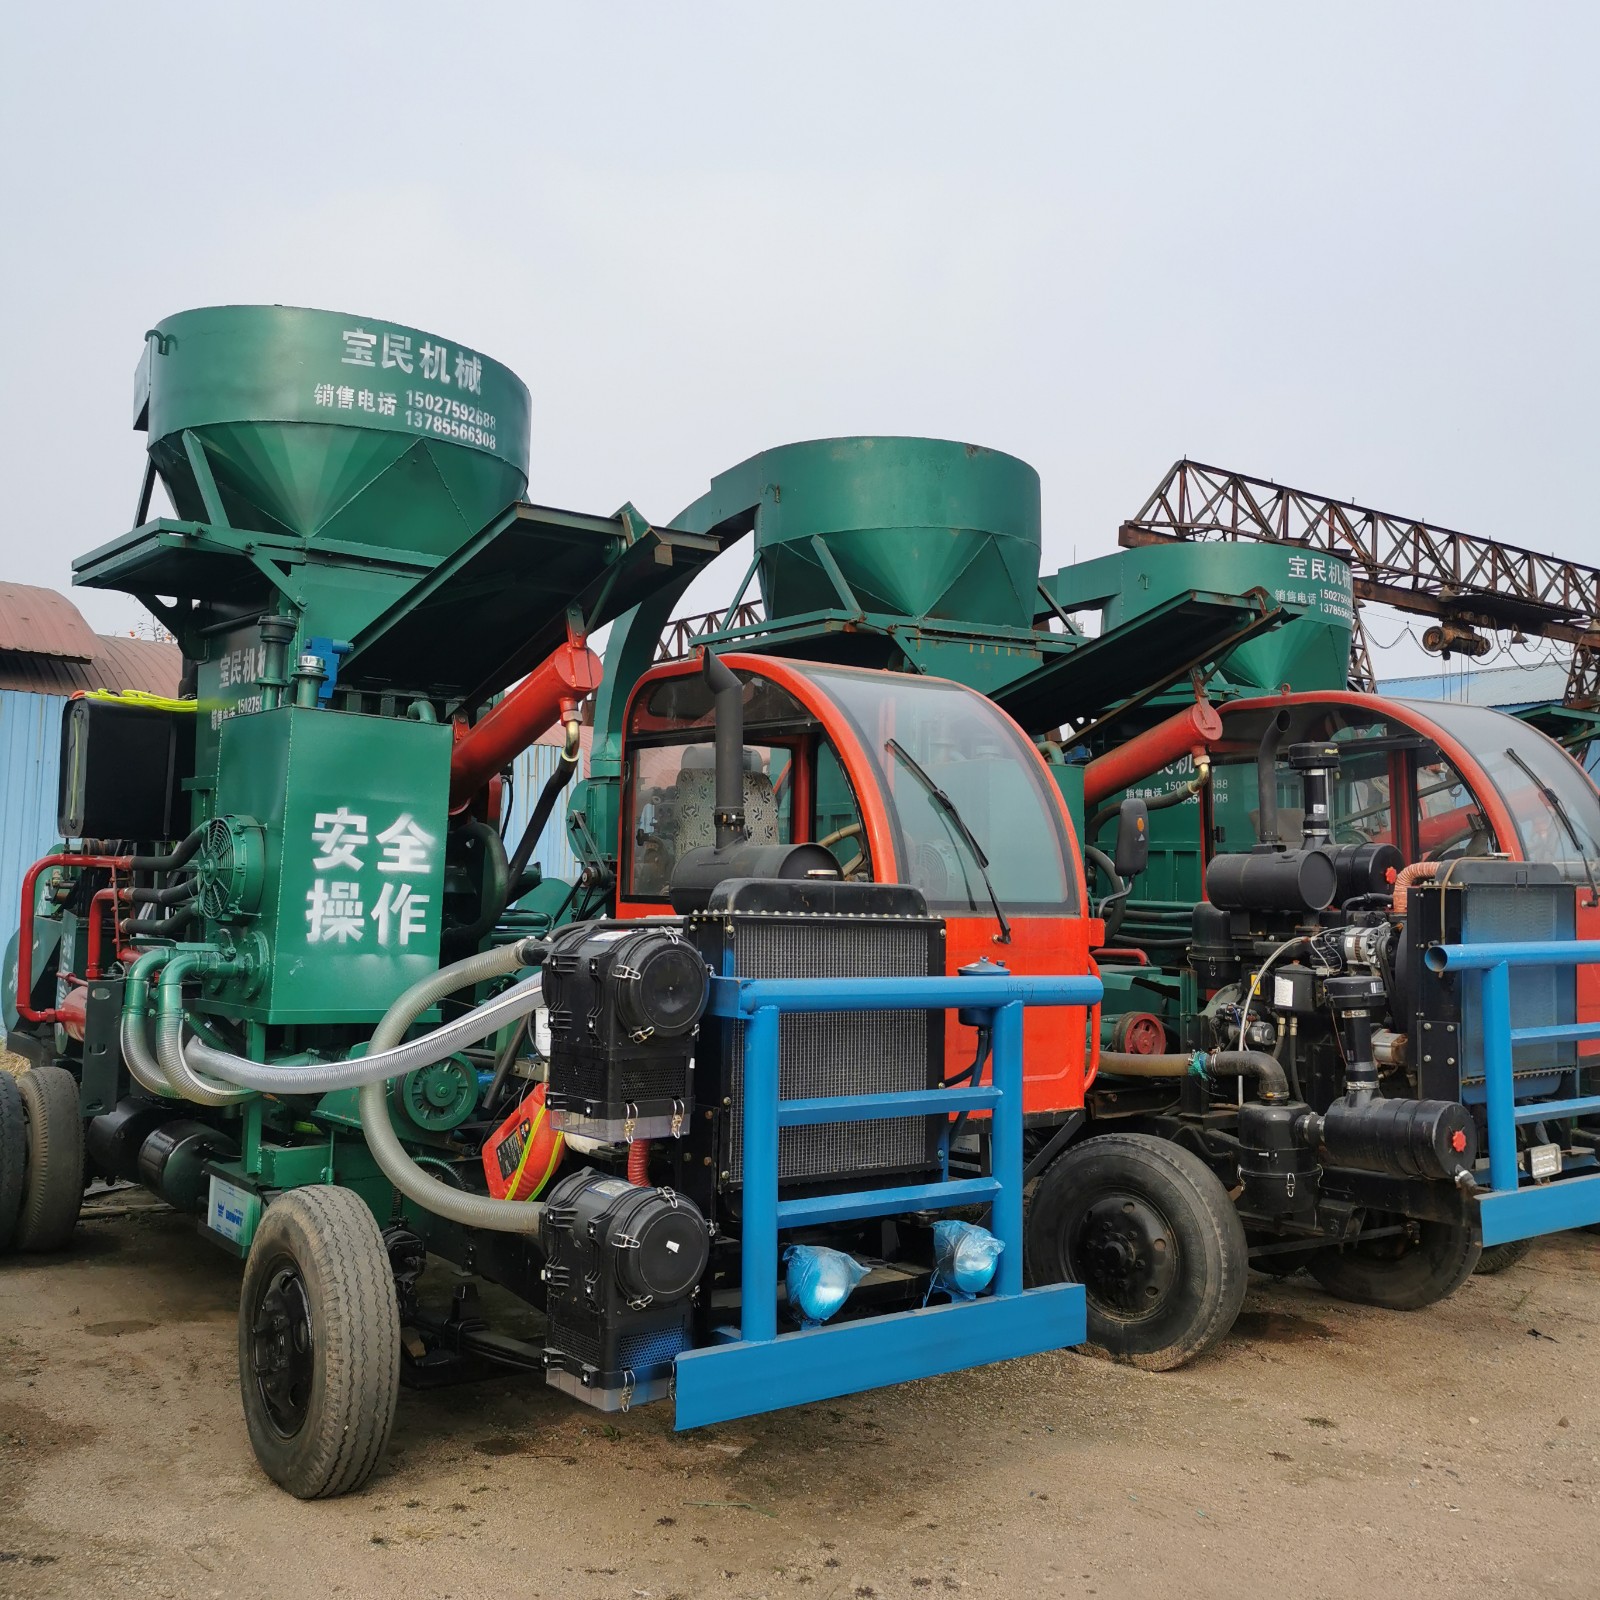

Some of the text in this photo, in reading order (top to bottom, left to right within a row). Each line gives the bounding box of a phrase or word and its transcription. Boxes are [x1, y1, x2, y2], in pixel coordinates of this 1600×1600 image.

[341, 328, 482, 395] 宝民机械
[314, 383, 496, 430] 销售电话 15027592688
[405, 410, 496, 450] 13785566308
[311, 807, 436, 873] 安全
[305, 878, 431, 946] 操作
